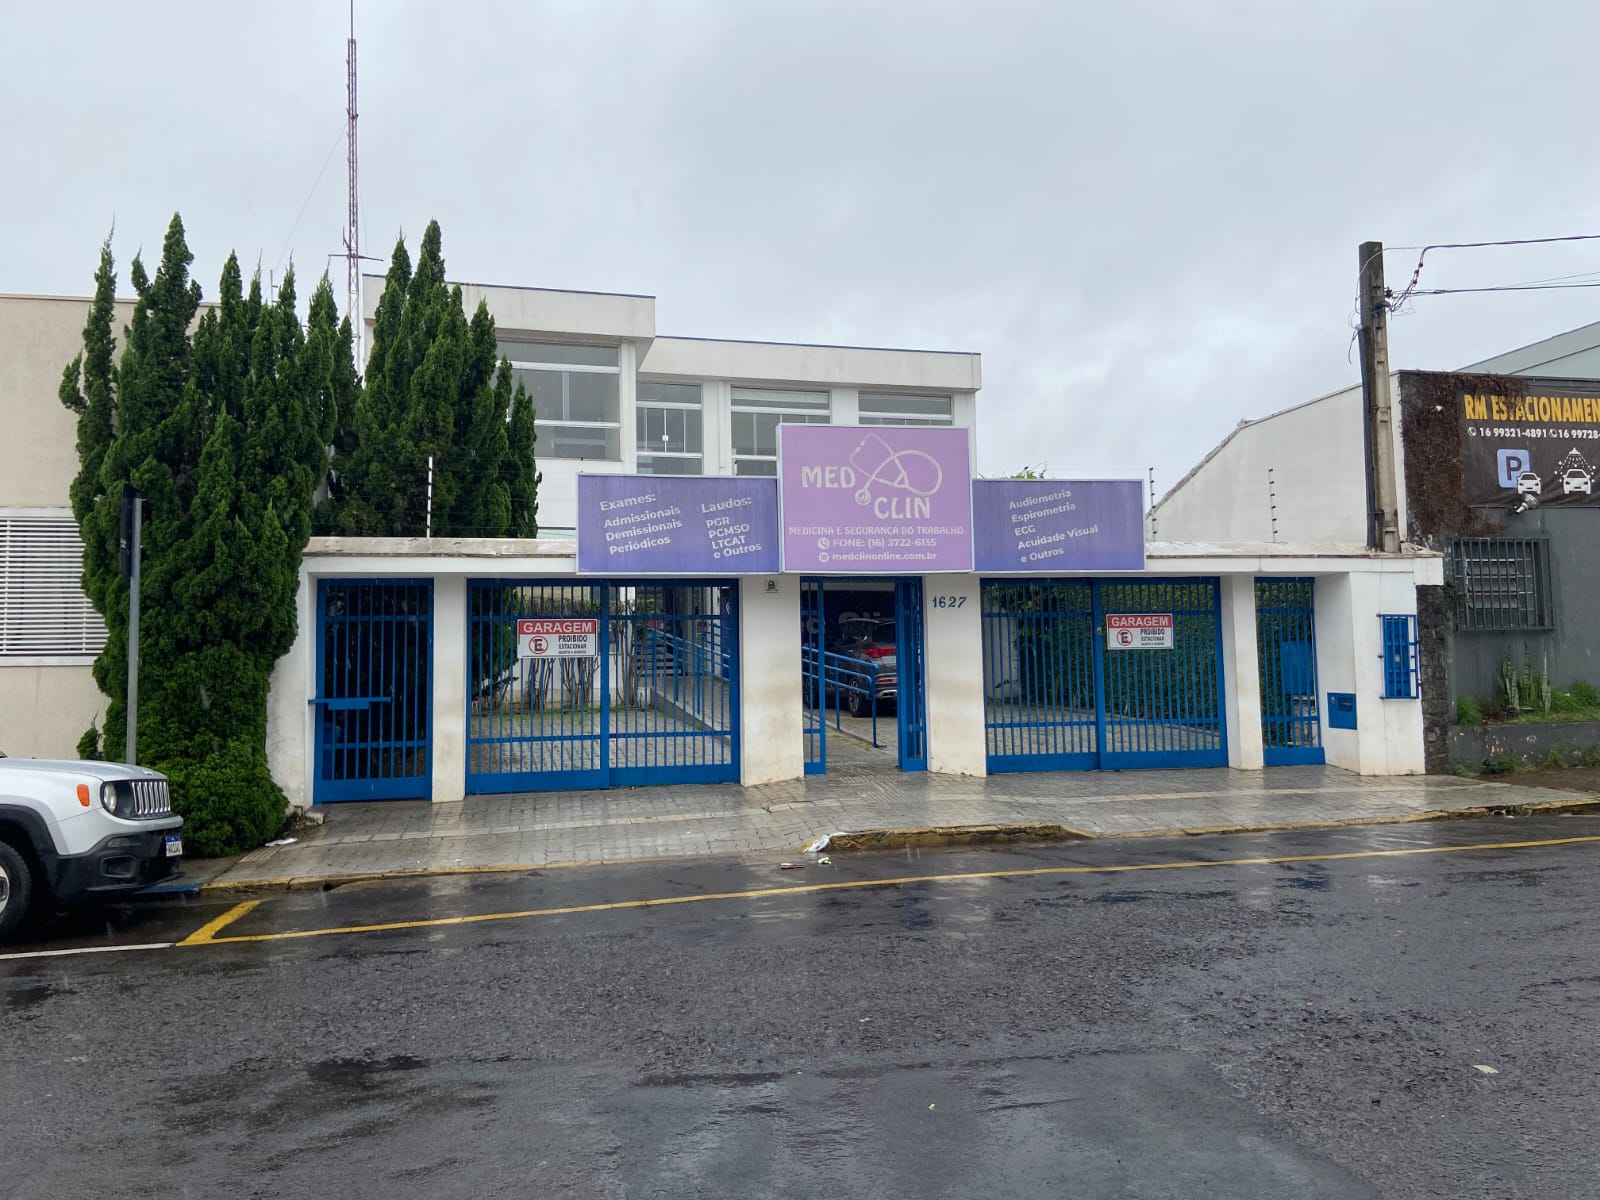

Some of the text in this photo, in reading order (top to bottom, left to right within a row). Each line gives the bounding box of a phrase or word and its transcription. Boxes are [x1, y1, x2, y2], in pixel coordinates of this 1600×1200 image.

[1463, 394, 1488, 419] RM
[1479, 427, 1547, 438] 16 99321-4891
[1558, 428, 1569, 438] 16
[1505, 456, 1522, 480] P
[801, 466, 856, 488] MED
[600, 494, 656, 511] Exames:
[701, 496, 752, 513] Laudos:
[873, 496, 931, 519] CLIN
[1008, 489, 1072, 510] Audiometria
[603, 505, 681, 528] Admissionais
[1011, 502, 1076, 522] Espirometria
[605, 519, 682, 541] Demissionais
[706, 516, 730, 528] PGR
[1014, 524, 1036, 536] ECG
[708, 524, 750, 538] PCMSO
[789, 526, 834, 535] MEDICINA
[836, 527, 843, 535] E
[902, 526, 914, 535] DO
[917, 526, 964, 535] TRABALHO
[1017, 524, 1098, 550] Acuidade Visual
[609, 536, 671, 555] Periódicos
[711, 535, 747, 549] LTCAT
[833, 538, 865, 547] FONE:
[867, 538, 885, 549] (16)
[713, 543, 762, 559] e Outros
[832, 551, 937, 561] medclinonline.com.br
[1020, 546, 1065, 563] e Outros
[932, 596, 967, 608] 1627
[523, 622, 592, 633] GARAGEM
[1111, 616, 1168, 627] GARAGEM
